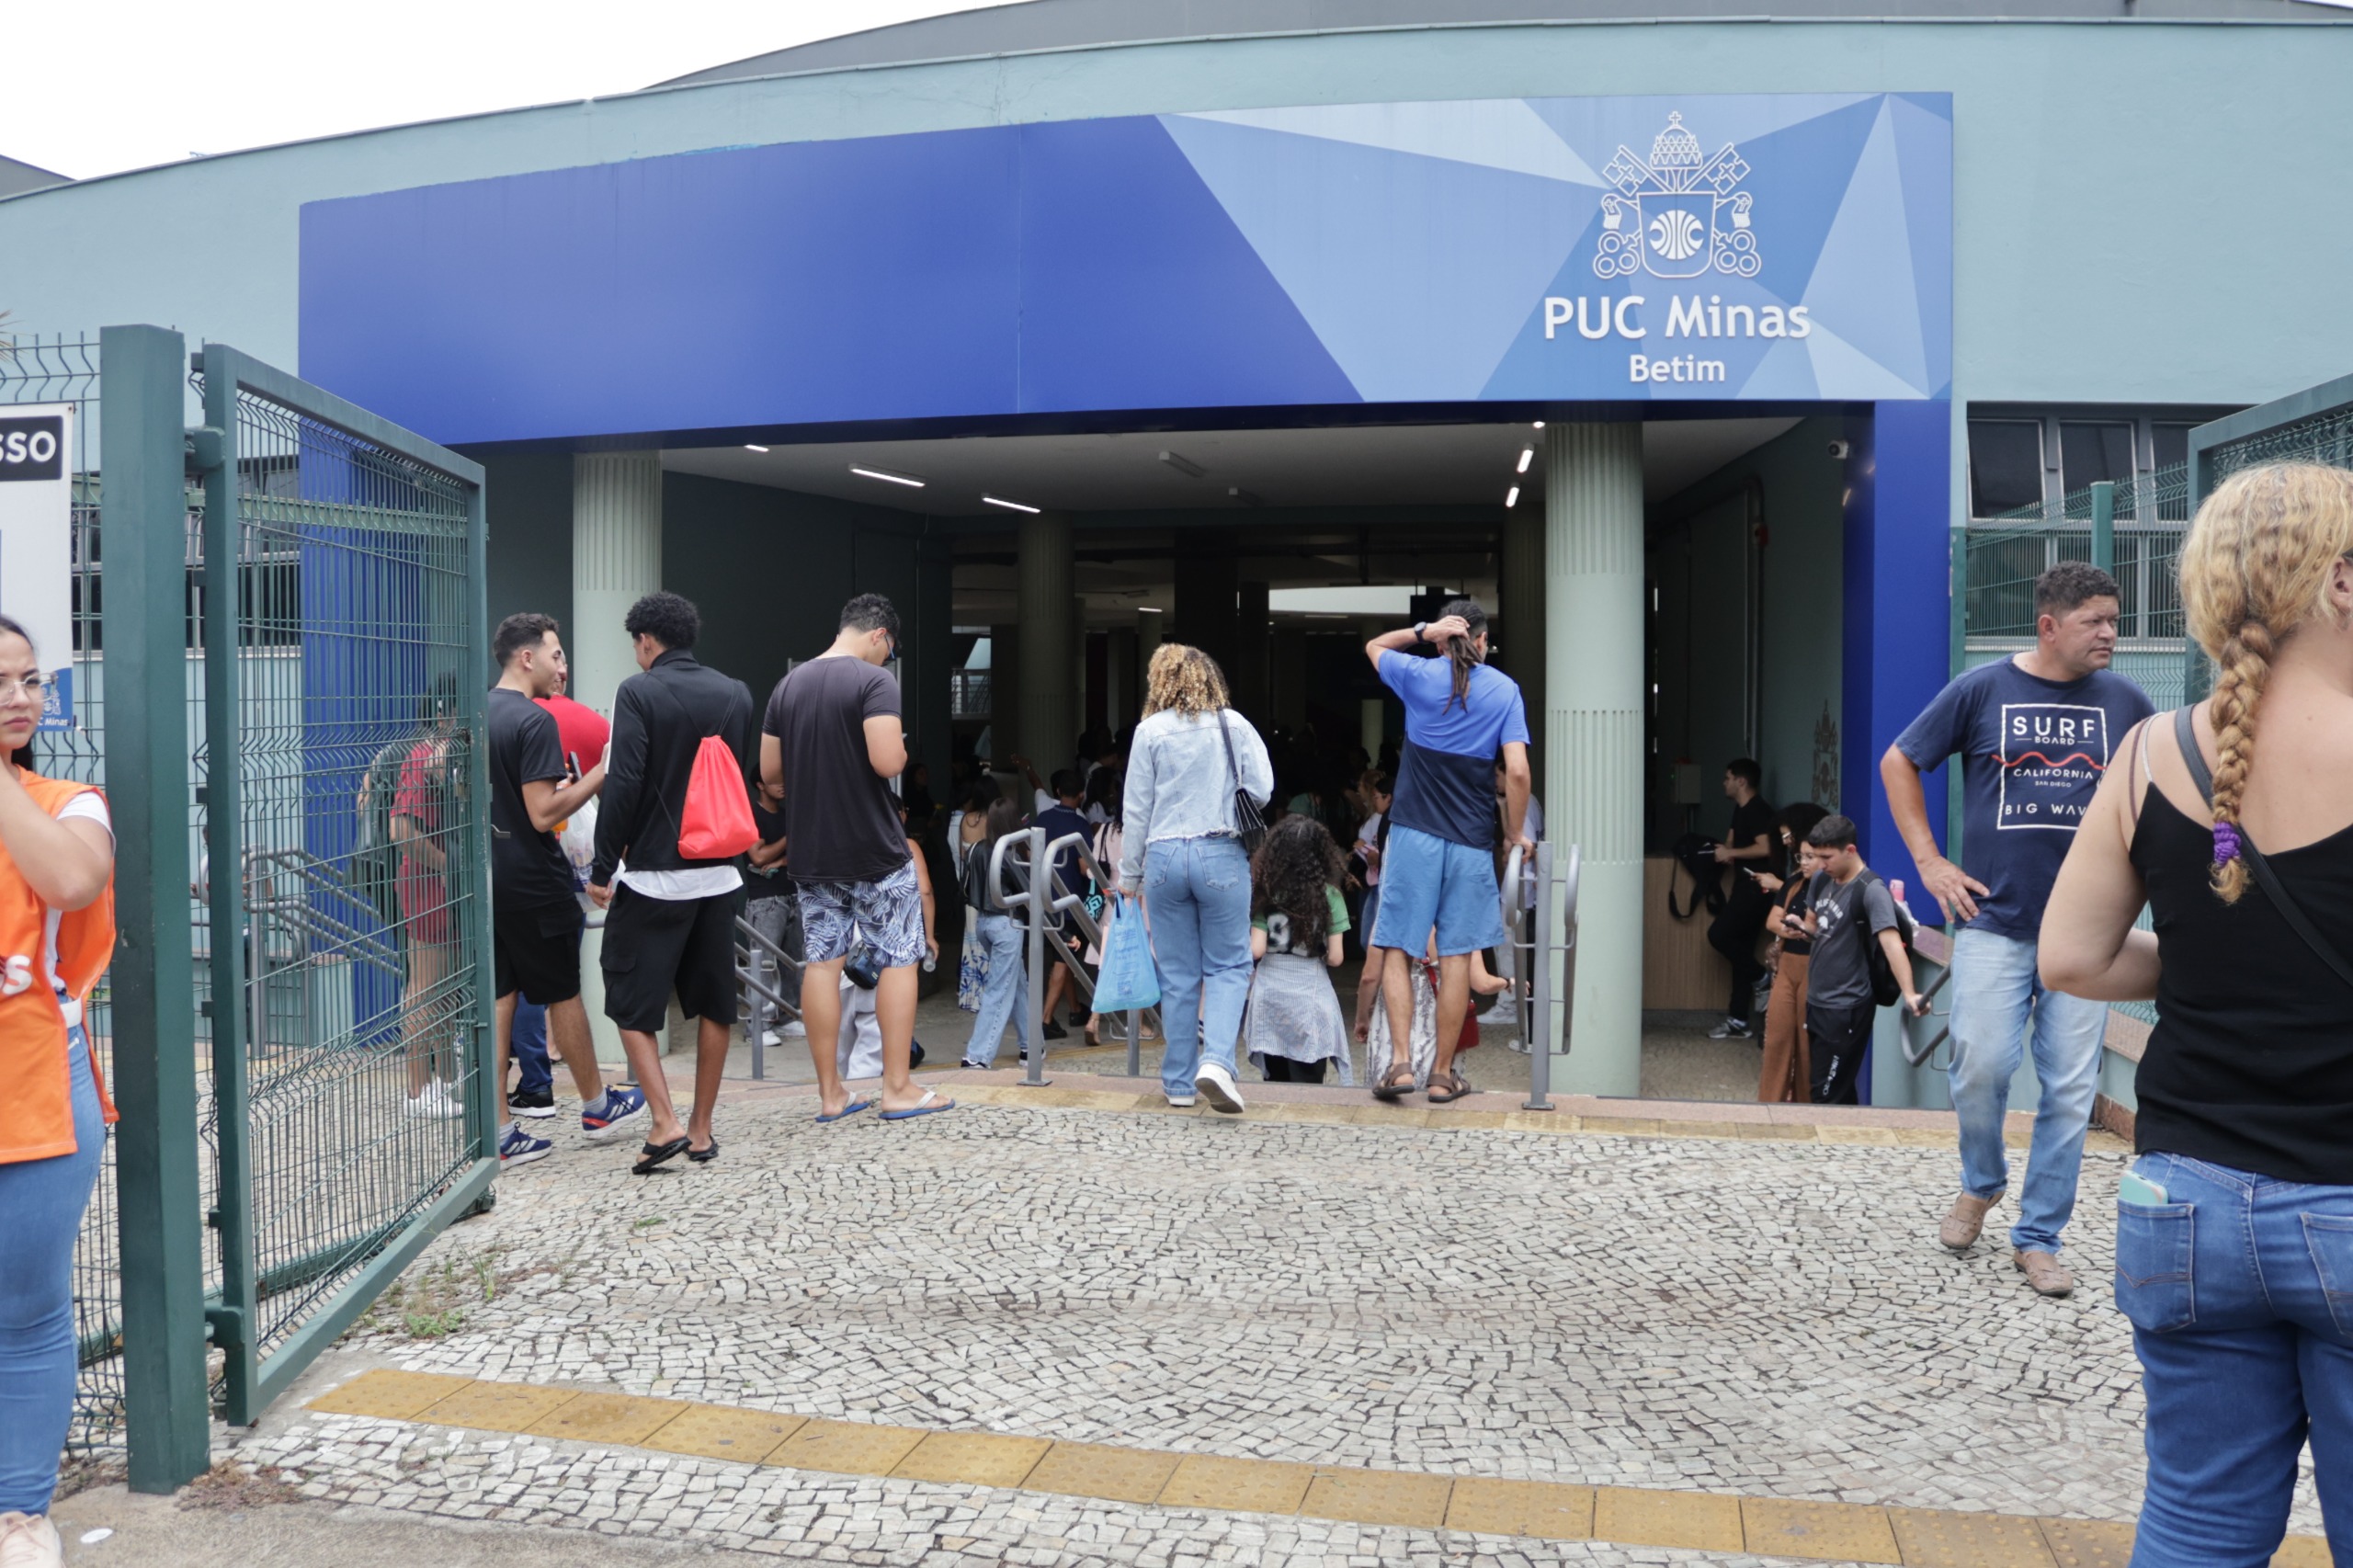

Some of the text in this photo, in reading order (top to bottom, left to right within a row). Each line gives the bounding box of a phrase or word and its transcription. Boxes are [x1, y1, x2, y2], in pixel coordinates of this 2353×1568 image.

[1545, 295, 1812, 339] PUC Minas
[1630, 354, 1725, 382] Betim
[0, 430, 57, 463] SO
[2012, 716, 2095, 737] SURF
[2034, 736, 2075, 745] BOARD
[2013, 768, 2094, 779] CALIFORNIA
[2005, 802, 2087, 816] BIG WAV
